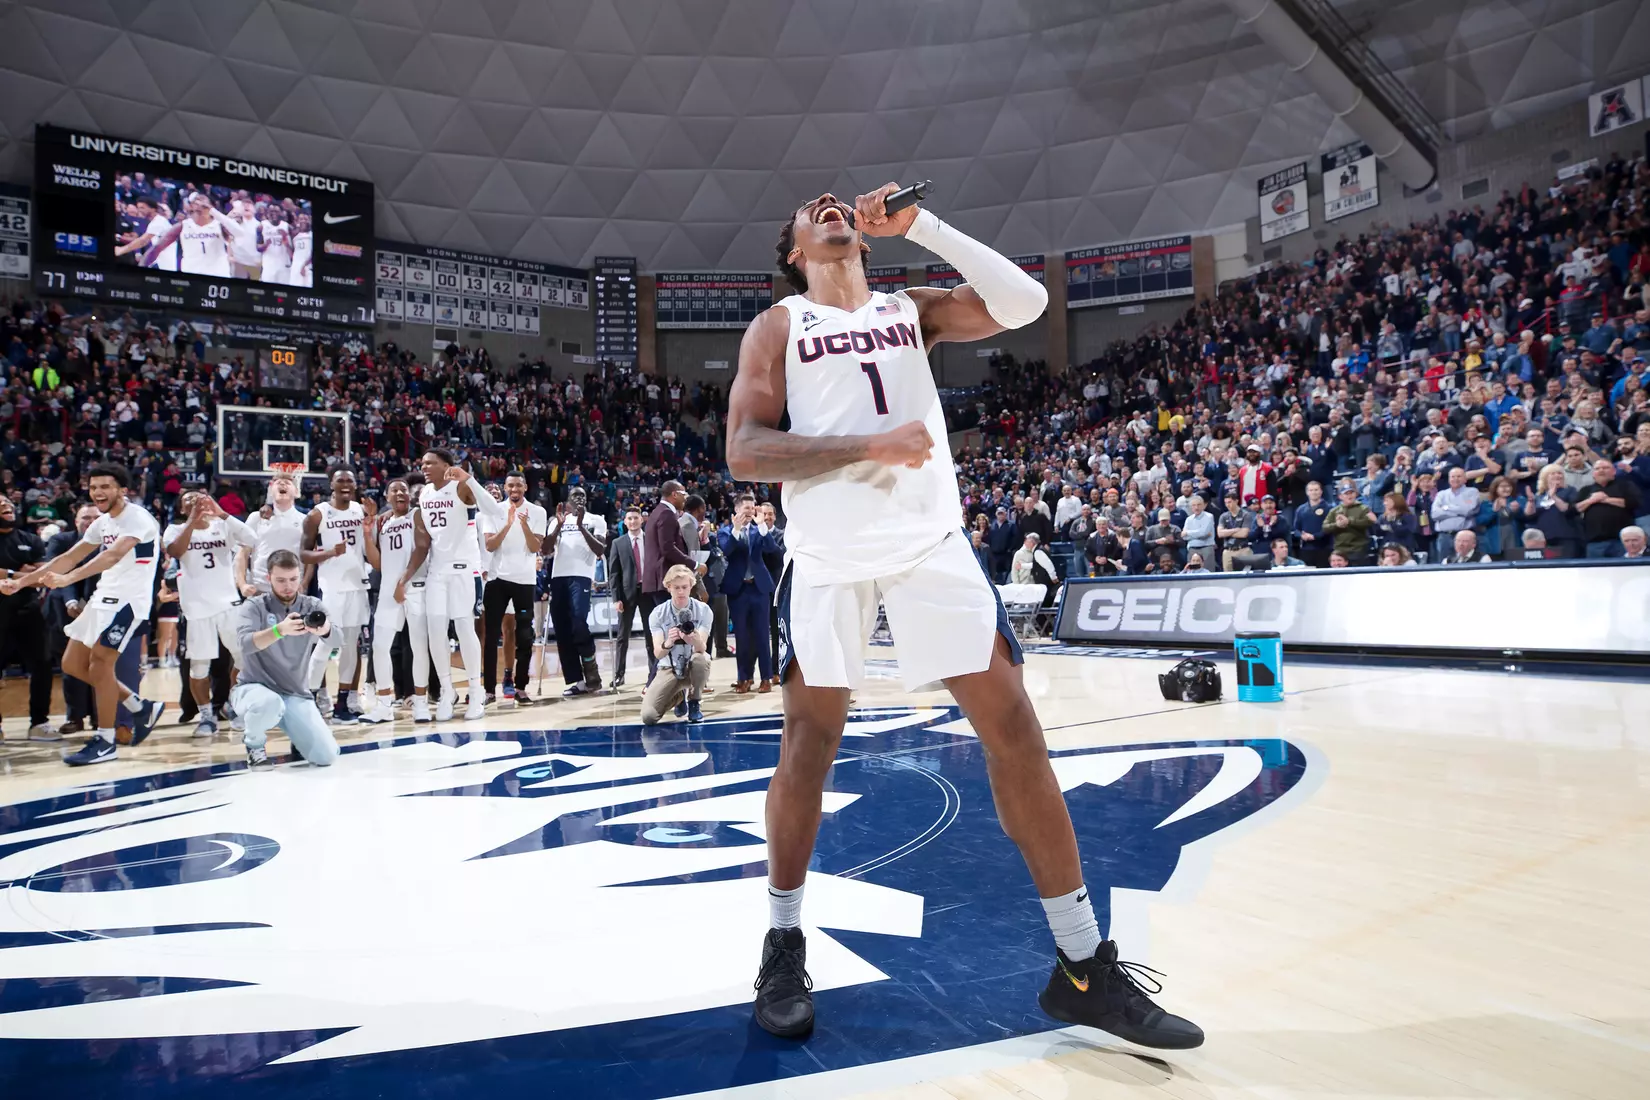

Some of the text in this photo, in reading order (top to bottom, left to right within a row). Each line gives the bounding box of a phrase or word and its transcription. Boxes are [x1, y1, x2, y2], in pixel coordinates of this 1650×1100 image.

[70, 134, 349, 194] UNIVERSITY OF CONNECTICUT
[53, 164, 100, 180] WELLS
[54, 174, 100, 190] FARGO
[1072, 237, 1184, 259] NCAA CHAMPIONSHIP
[426, 247, 457, 258] UCONN
[461, 253, 499, 264] HUSKIES
[517, 261, 545, 271] HONOR
[380, 265, 400, 280] 52
[865, 268, 901, 277] ONSHIP
[932, 265, 955, 273] NCA
[438, 273, 457, 287] 00
[467, 278, 482, 290] 13
[493, 282, 511, 294] 42
[522, 285, 533, 297] 34
[385, 300, 395, 314] 15
[413, 304, 425, 317] 22
[468, 311, 481, 324] 42
[496, 314, 508, 327] 13
[525, 317, 531, 329] 3
[797, 323, 918, 363] UCONN
[861, 361, 889, 415] 1
[185, 472, 206, 483] 114
[422, 500, 453, 509] UCONN
[327, 518, 362, 529] UCONN
[429, 511, 447, 527] 25
[340, 529, 356, 546] 15
[389, 534, 402, 550] 10
[187, 539, 226, 551] UCONN
[202, 552, 215, 569] 3
[1077, 585, 1298, 634] GEICO
